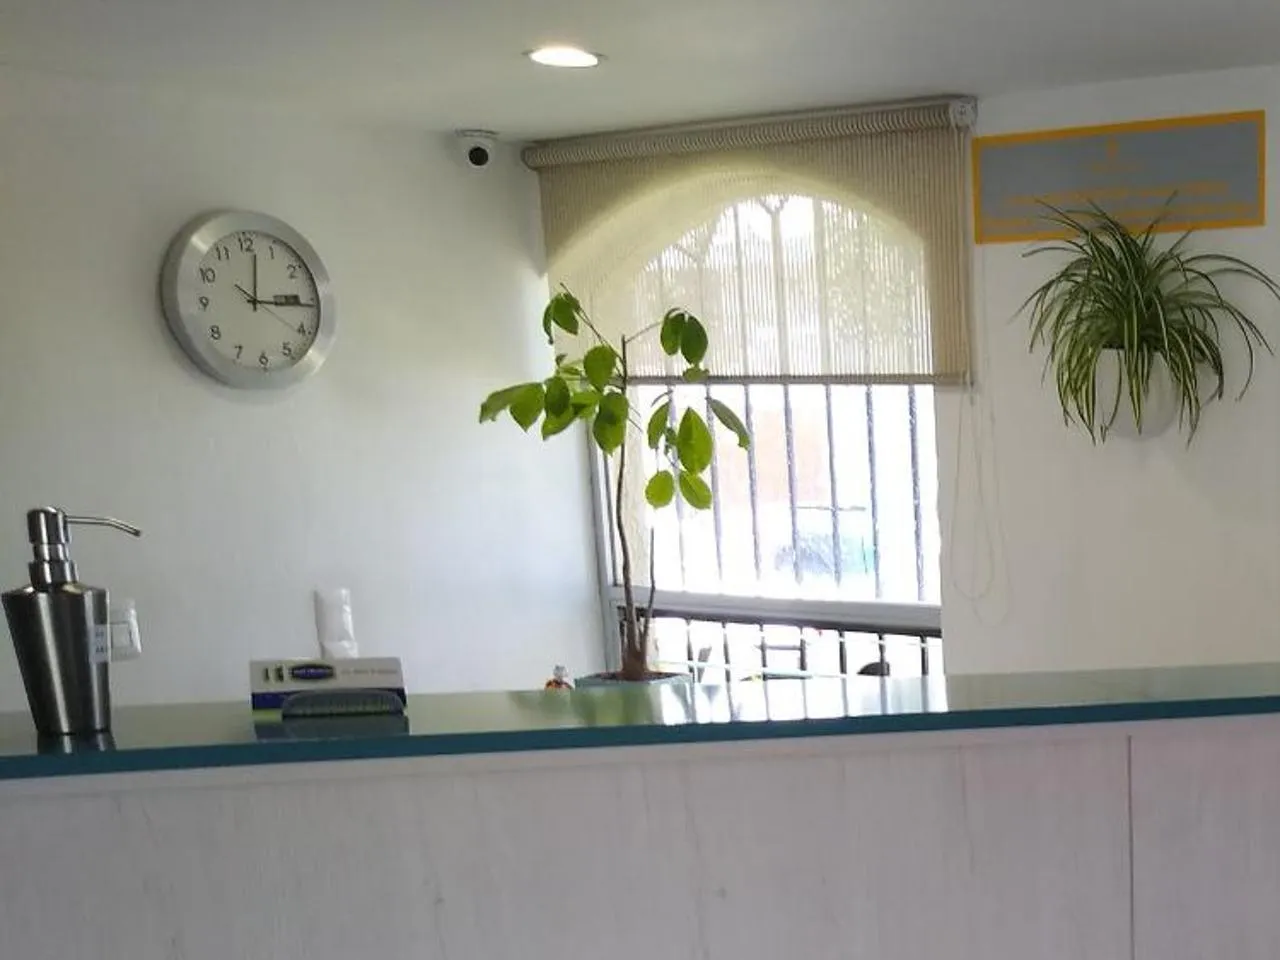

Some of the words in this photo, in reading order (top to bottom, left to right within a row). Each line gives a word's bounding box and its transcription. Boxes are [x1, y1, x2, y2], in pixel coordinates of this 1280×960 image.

[238, 236, 254, 253] 12
[268, 245, 275, 260] 1
[216, 245, 231, 261] 11
[199, 267, 216, 284] 10
[287, 263, 298, 280] 2
[198, 296, 210, 312] 9
[209, 325, 222, 340] 8
[296, 321, 306, 337] 4
[234, 344, 244, 360] 7
[282, 341, 292, 357] 5
[258, 350, 269, 366] 6
